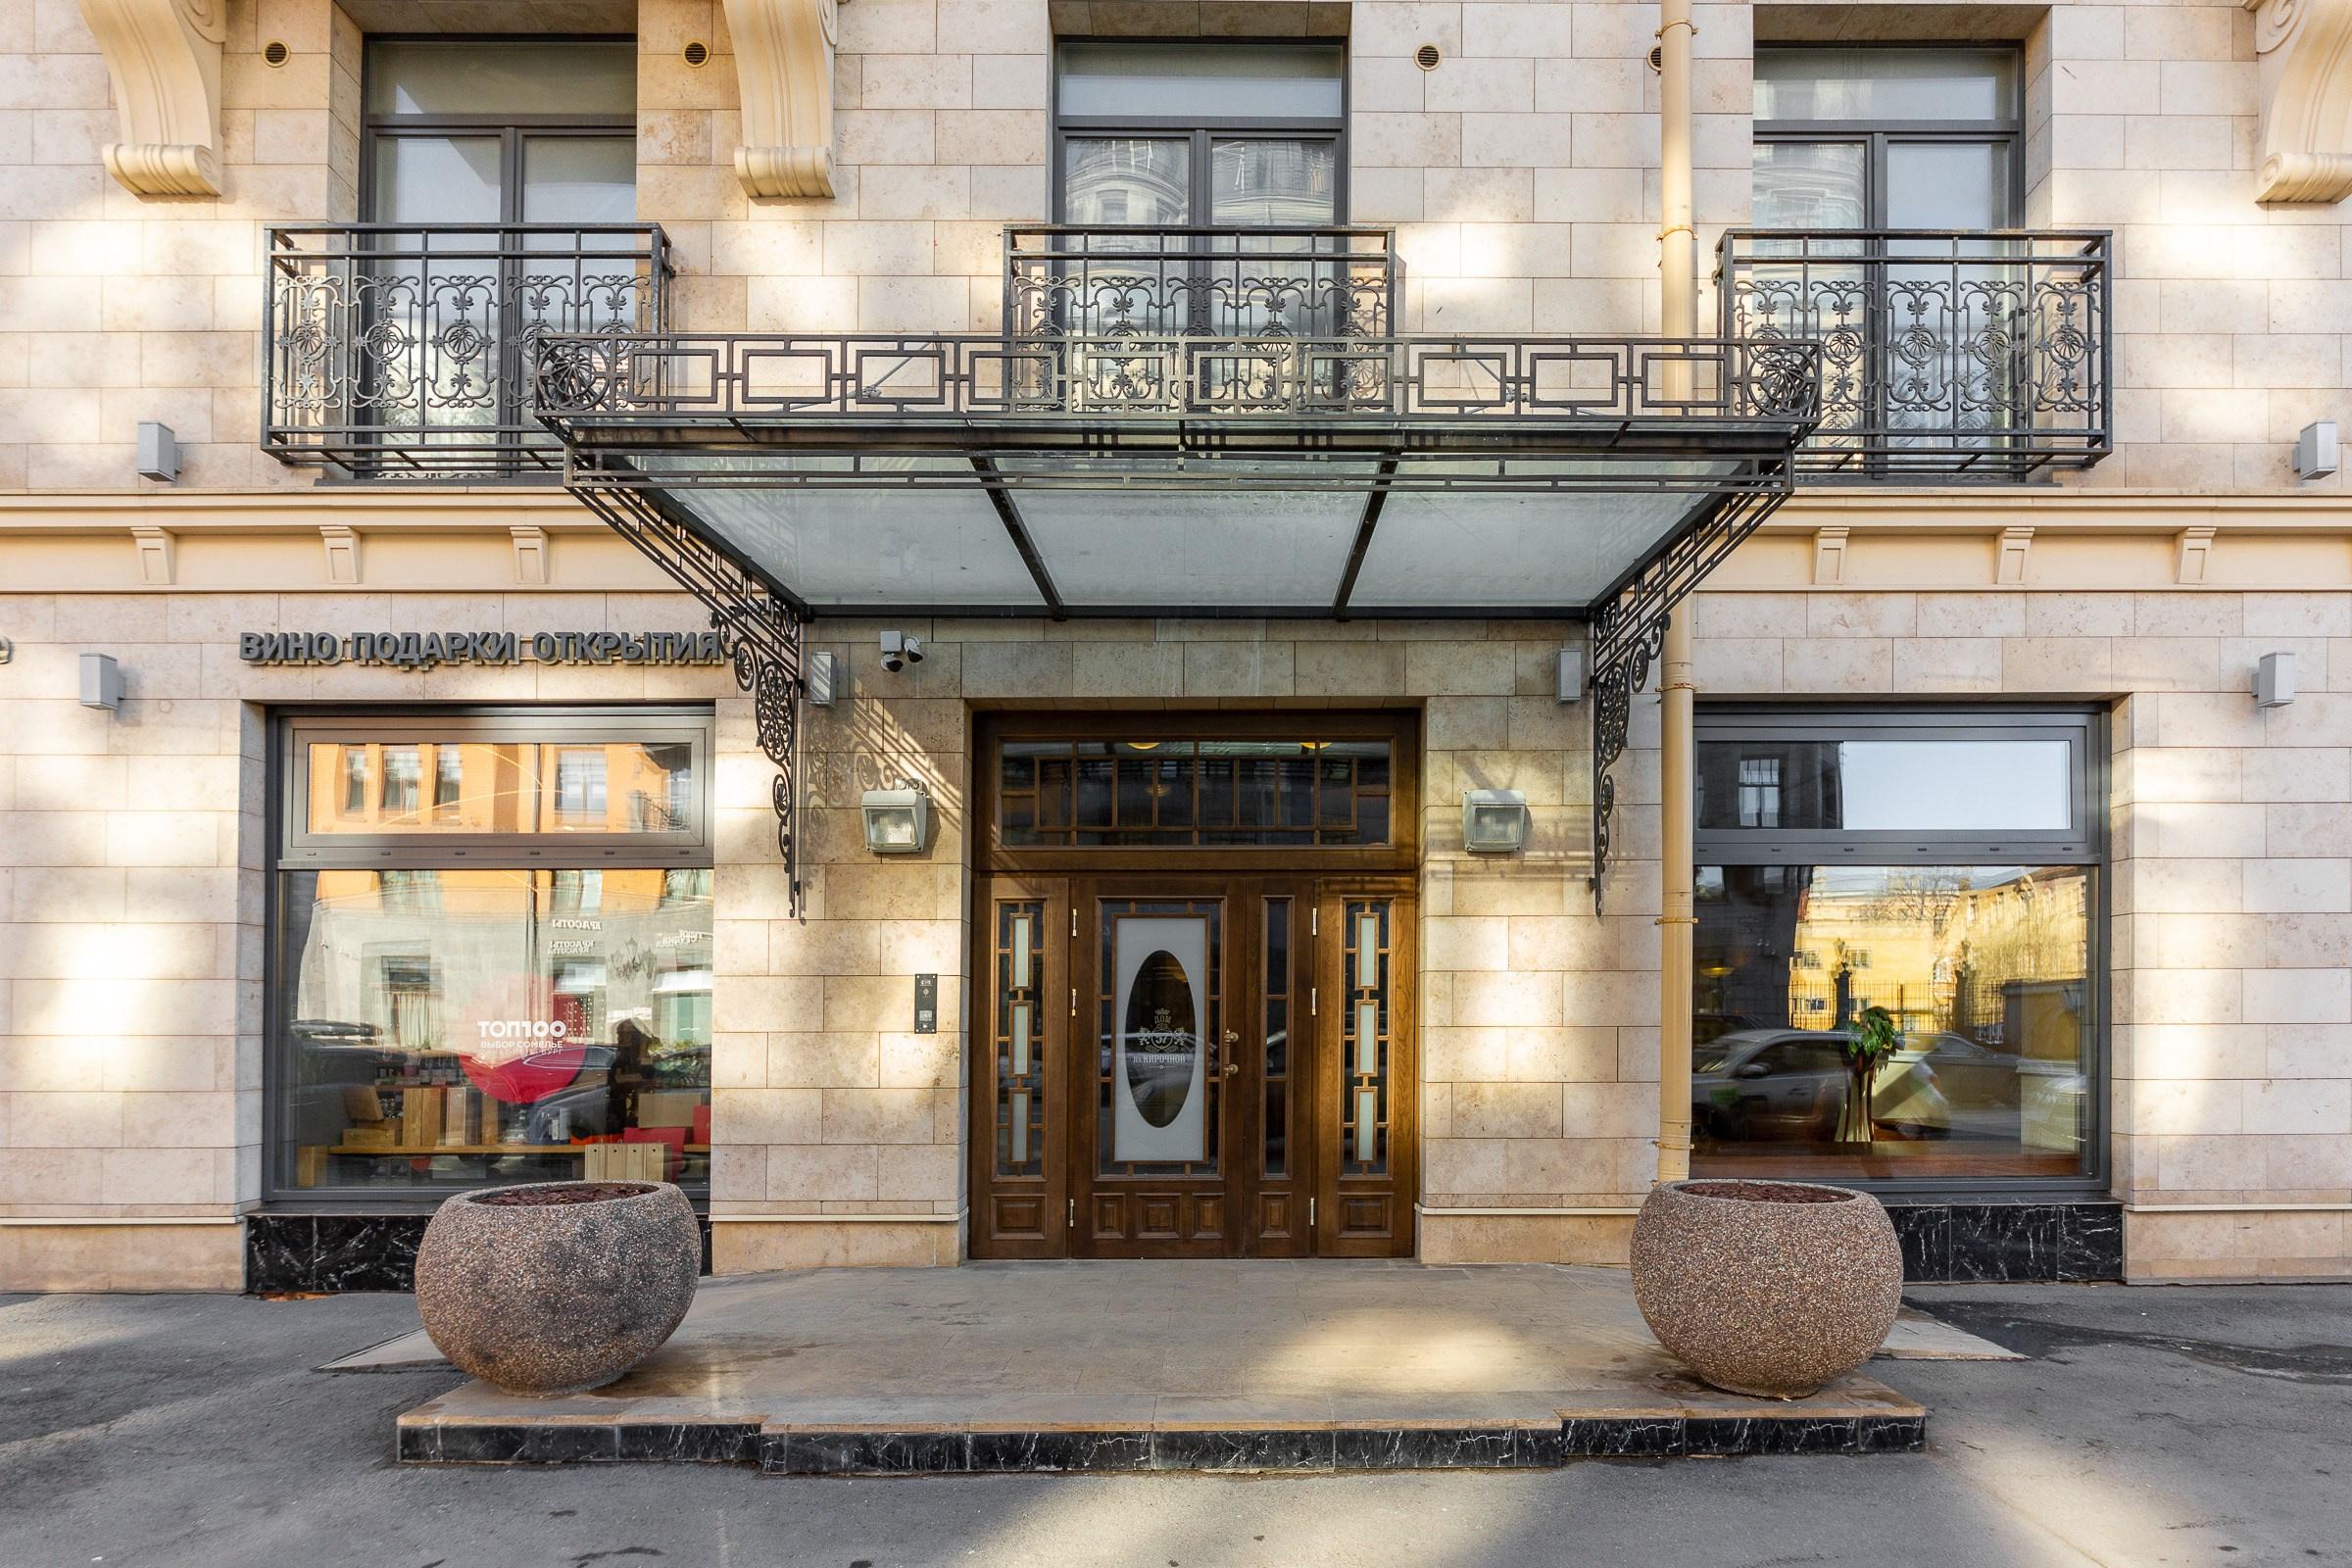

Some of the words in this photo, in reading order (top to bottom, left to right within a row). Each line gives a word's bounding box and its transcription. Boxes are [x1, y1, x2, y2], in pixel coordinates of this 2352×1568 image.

[239, 632, 339, 662] ВИНО
[351, 632, 516, 666] ПОДАРКИ
[532, 632, 720, 662] ОТКРЫТИЯ
[1143, 1054, 1186, 1063] КИРОЧНОЙ
